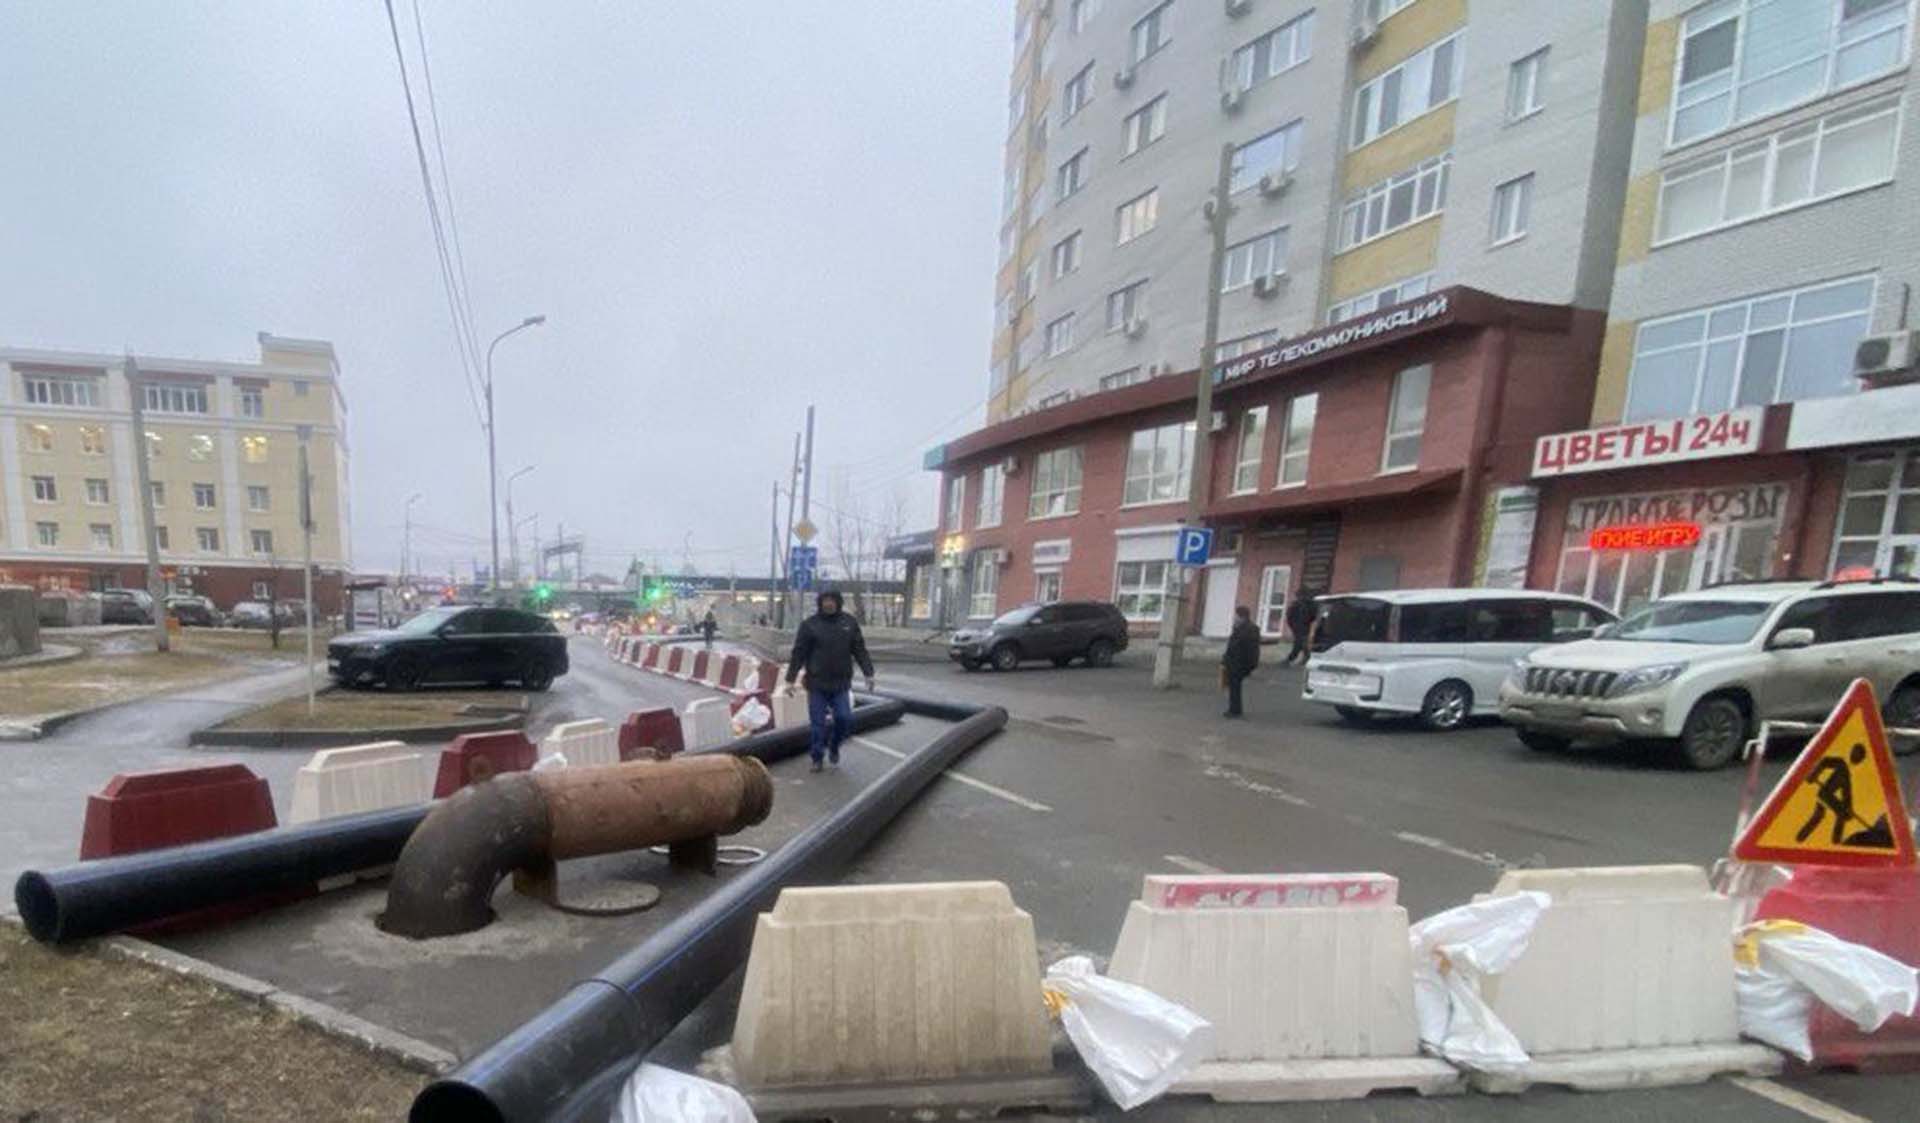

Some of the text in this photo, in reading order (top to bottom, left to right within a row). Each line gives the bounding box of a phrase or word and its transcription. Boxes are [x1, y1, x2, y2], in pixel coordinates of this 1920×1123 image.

[1224, 296, 1447, 381] МИР ТЕЛЕКОММУНИКАЦИЙ
[1539, 413, 1750, 473] ЦВЕТЫ 24ч
[1183, 531, 1205, 562] P
